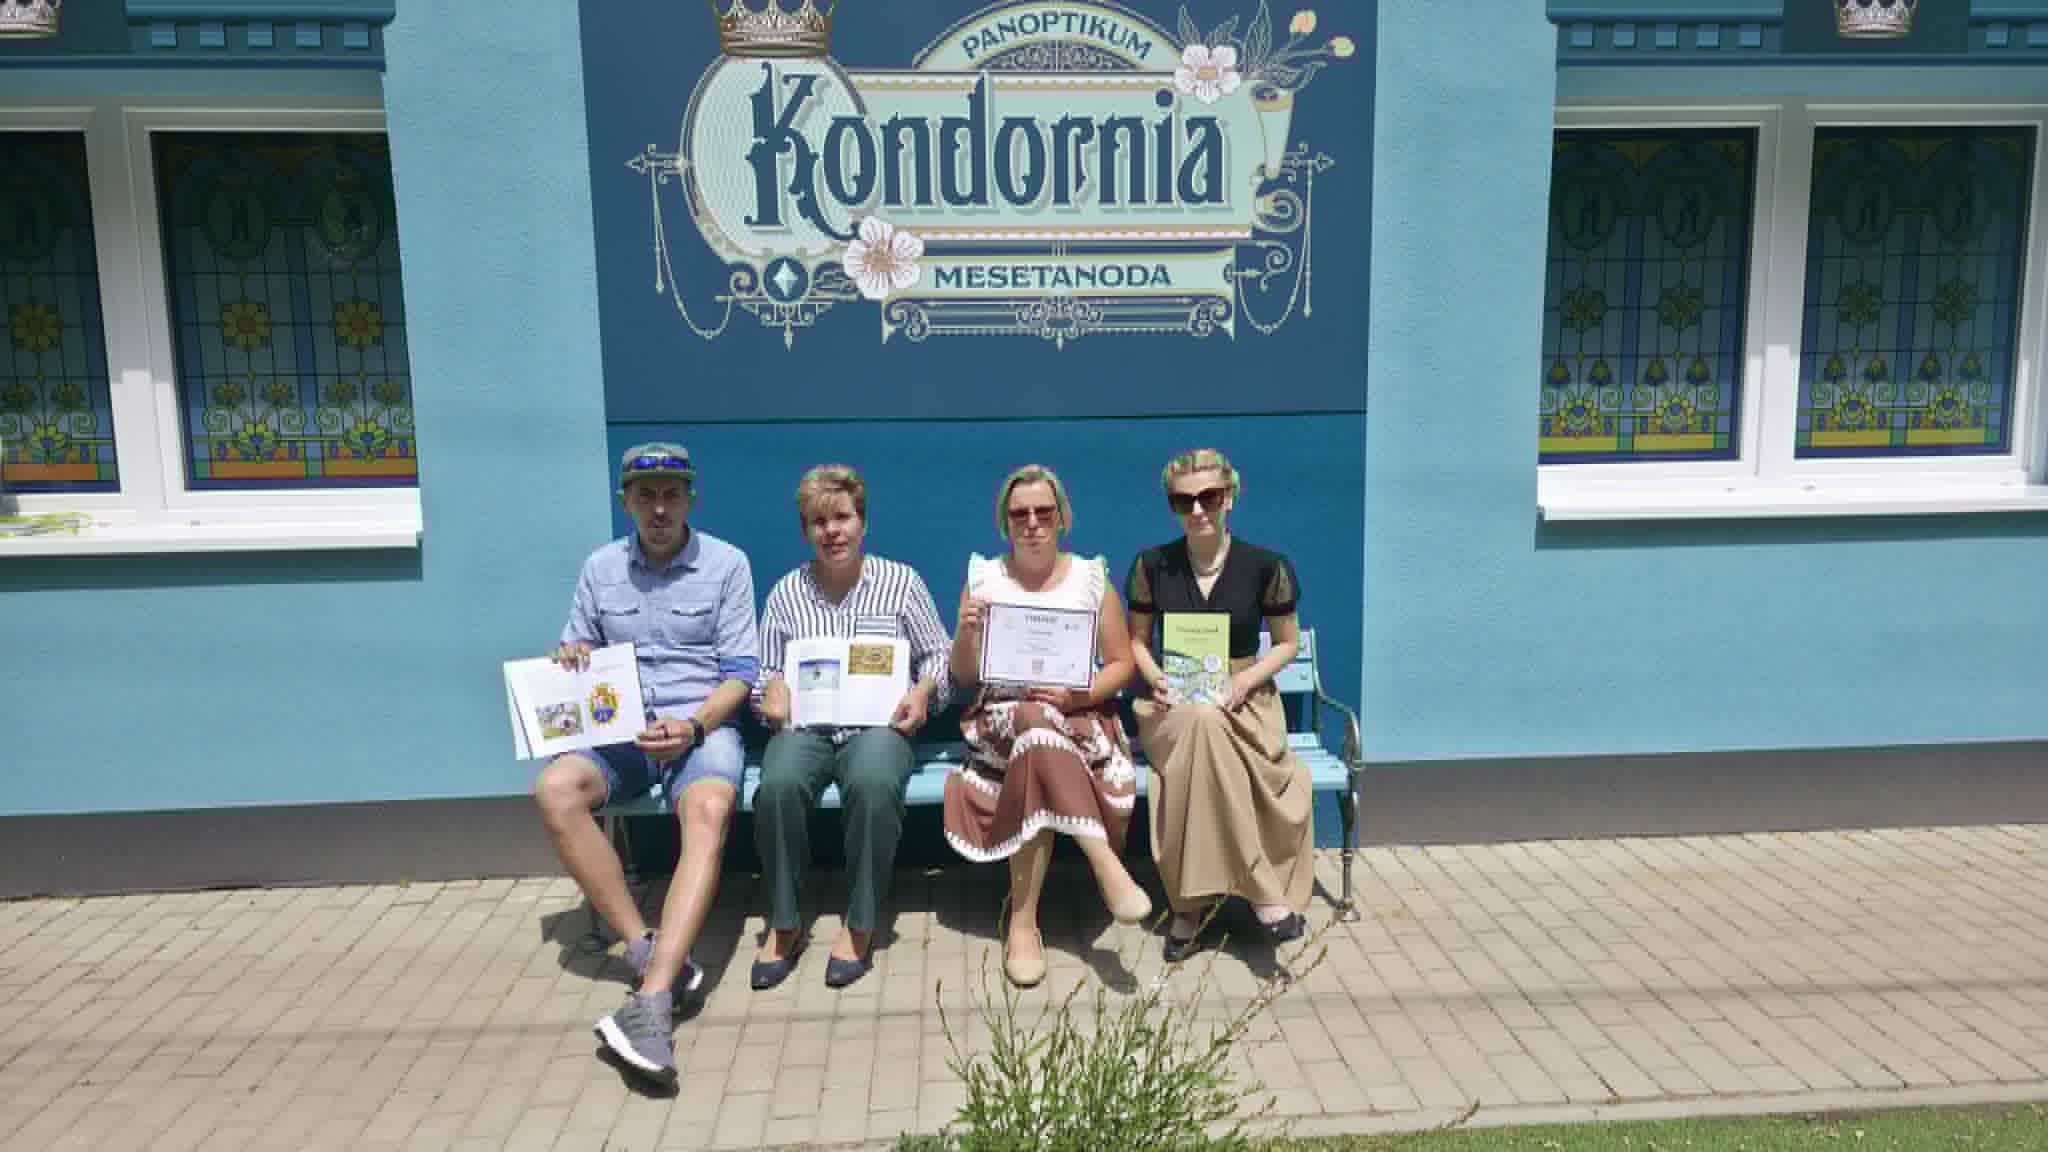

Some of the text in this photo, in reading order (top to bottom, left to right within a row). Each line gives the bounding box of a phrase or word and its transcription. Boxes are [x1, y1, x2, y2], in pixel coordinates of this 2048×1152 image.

[962, 11, 1153, 60] PANOPTIKUM
[744, 62, 1226, 240] Kondornia
[934, 263, 1172, 289] MESETANODA
